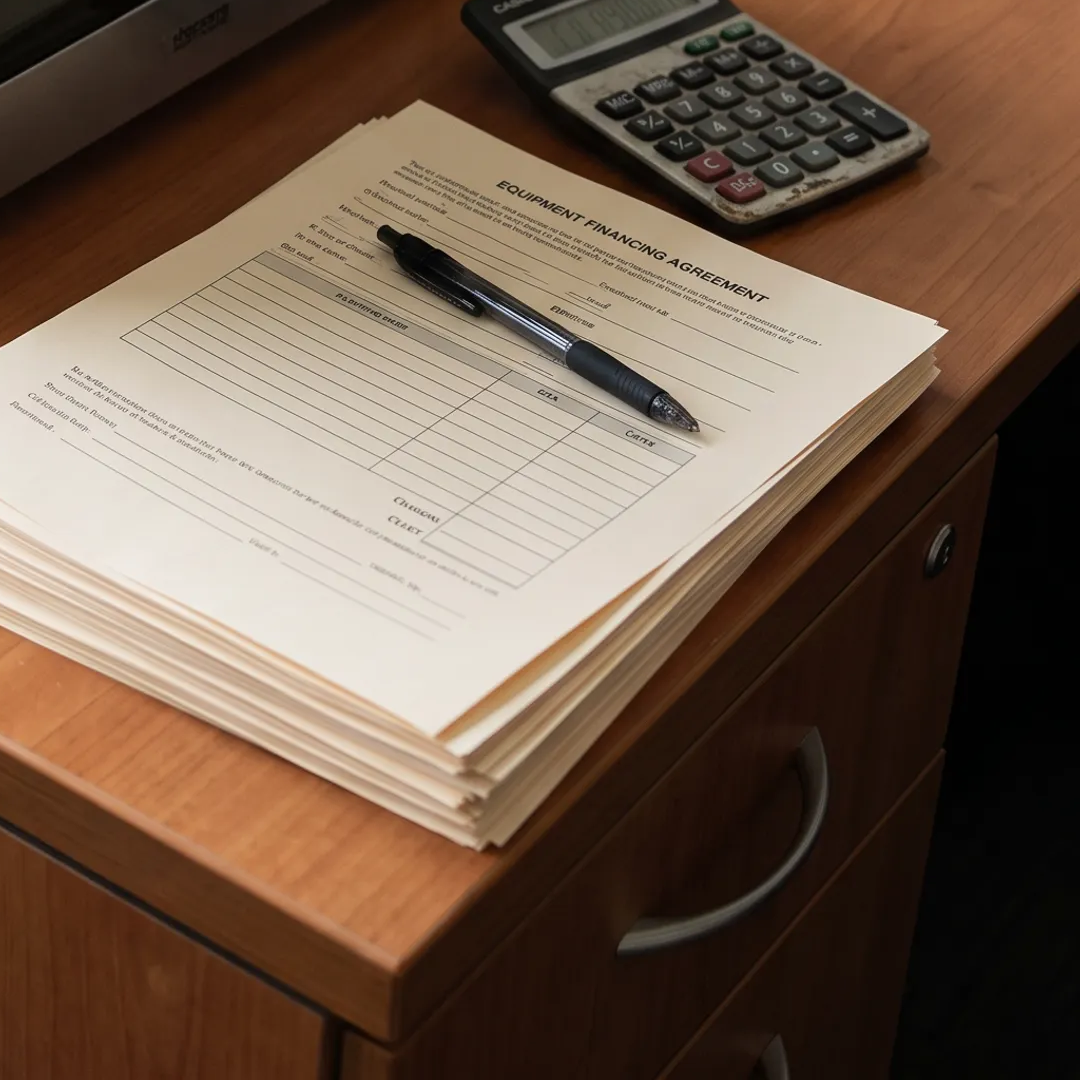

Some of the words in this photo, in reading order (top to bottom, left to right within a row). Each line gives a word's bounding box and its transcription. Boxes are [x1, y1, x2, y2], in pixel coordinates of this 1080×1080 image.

[678, 100, 693, 113] 7
[714, 86, 732, 98] 8
[748, 72, 764, 84] 9
[713, 121, 727, 132] 4
[745, 104, 762, 118] 5
[780, 91, 796, 104] 6
[742, 141, 757, 153] 1
[774, 125, 794, 139] 2
[809, 111, 827, 124] 3
[703, 156, 720, 169] C
[772, 161, 789, 175] 0
[496, 180, 586, 222] EQUIPMENT
[584, 219, 668, 261] FINANCING
[667, 257, 770, 304] AGREEMENT
